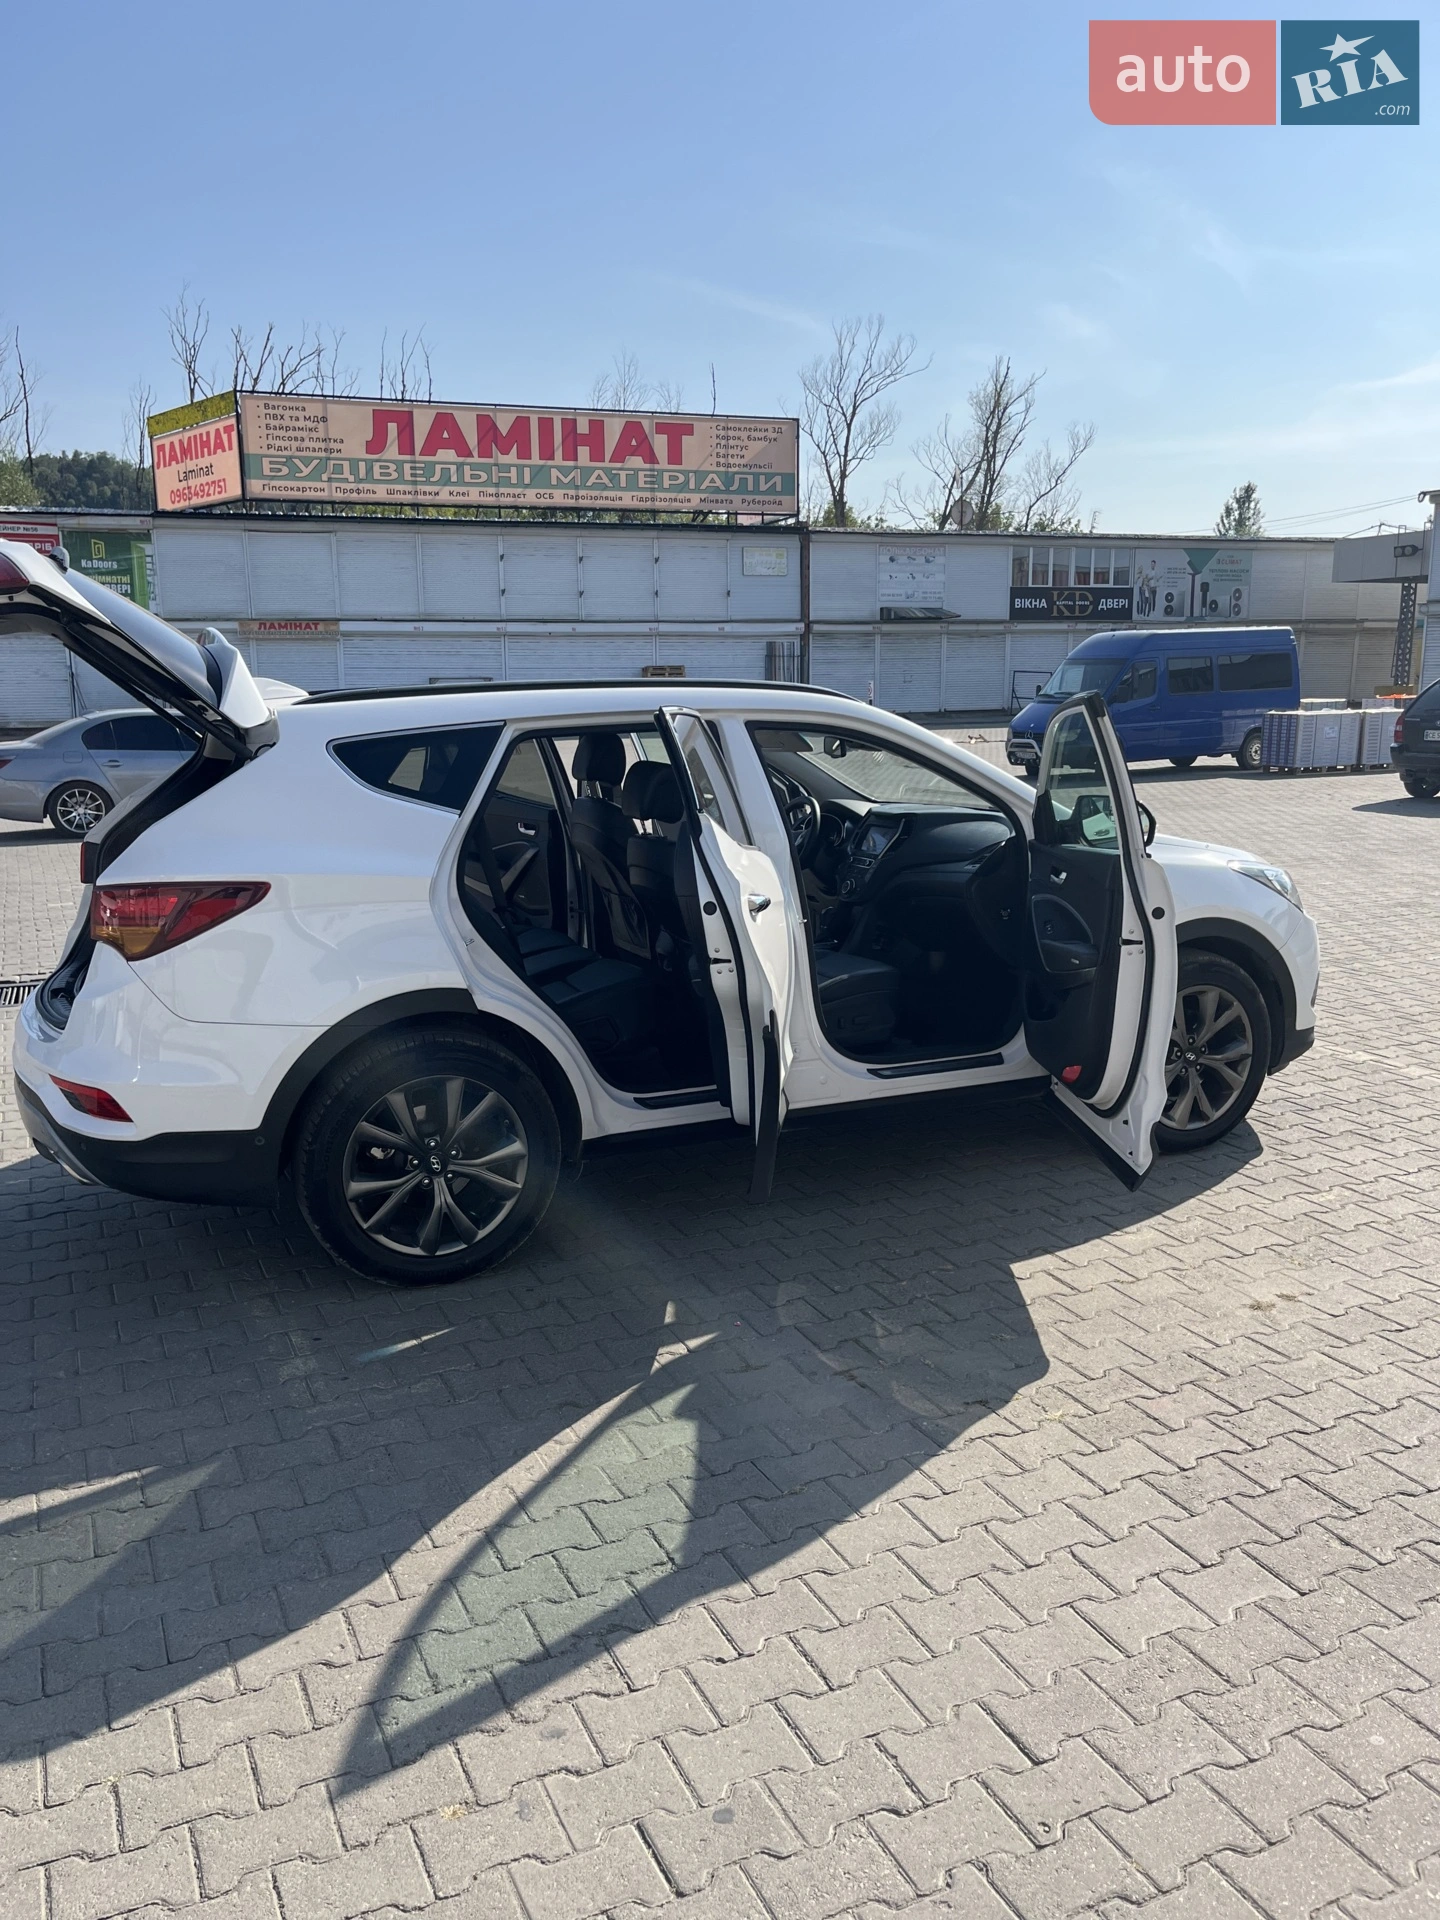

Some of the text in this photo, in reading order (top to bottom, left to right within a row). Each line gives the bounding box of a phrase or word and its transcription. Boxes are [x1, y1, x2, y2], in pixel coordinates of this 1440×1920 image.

[263, 402, 307, 413] Вагонка
[264, 413, 285, 421] ПВХ
[303, 415, 329, 424] МДФ
[265, 423, 320, 433] Байрамікс
[715, 424, 769, 434] Самоклейки
[265, 433, 345, 445] Гіпсова плитка
[365, 408, 694, 466] ЛАМІНАТ
[715, 434, 778, 444] Корок, бамбук
[156, 424, 235, 470] ЛАМІНАТ
[266, 443, 342, 455] Рідкі шпалери
[715, 443, 749, 452] Плінтус
[715, 452, 745, 460] Багети
[715, 461, 773, 471] Водоемульсії
[177, 462, 214, 483] Laminat
[260, 456, 783, 493] БУДІВЕЛЬНІ МАТЕРІАЛИ
[169, 478, 227, 505] 0963492751
[262, 483, 326, 494] Гіпсокартон
[335, 486, 377, 496] Профіль
[386, 487, 440, 498] Шпаклівки
[448, 489, 470, 498] Клеї
[478, 490, 527, 500] Пінопласт
[535, 492, 555, 500] ОСБ
[563, 493, 623, 503] Пароізоляція
[631, 495, 692, 505] Гідроізоляція
[699, 497, 734, 506] Мінвата
[81, 559, 118, 569] KaDoors
[90, 574, 131, 584] імнатні
[1014, 598, 1129, 611] ВІКНА ДВЕРІ
[257, 622, 320, 631] ЛАМІНАТ
